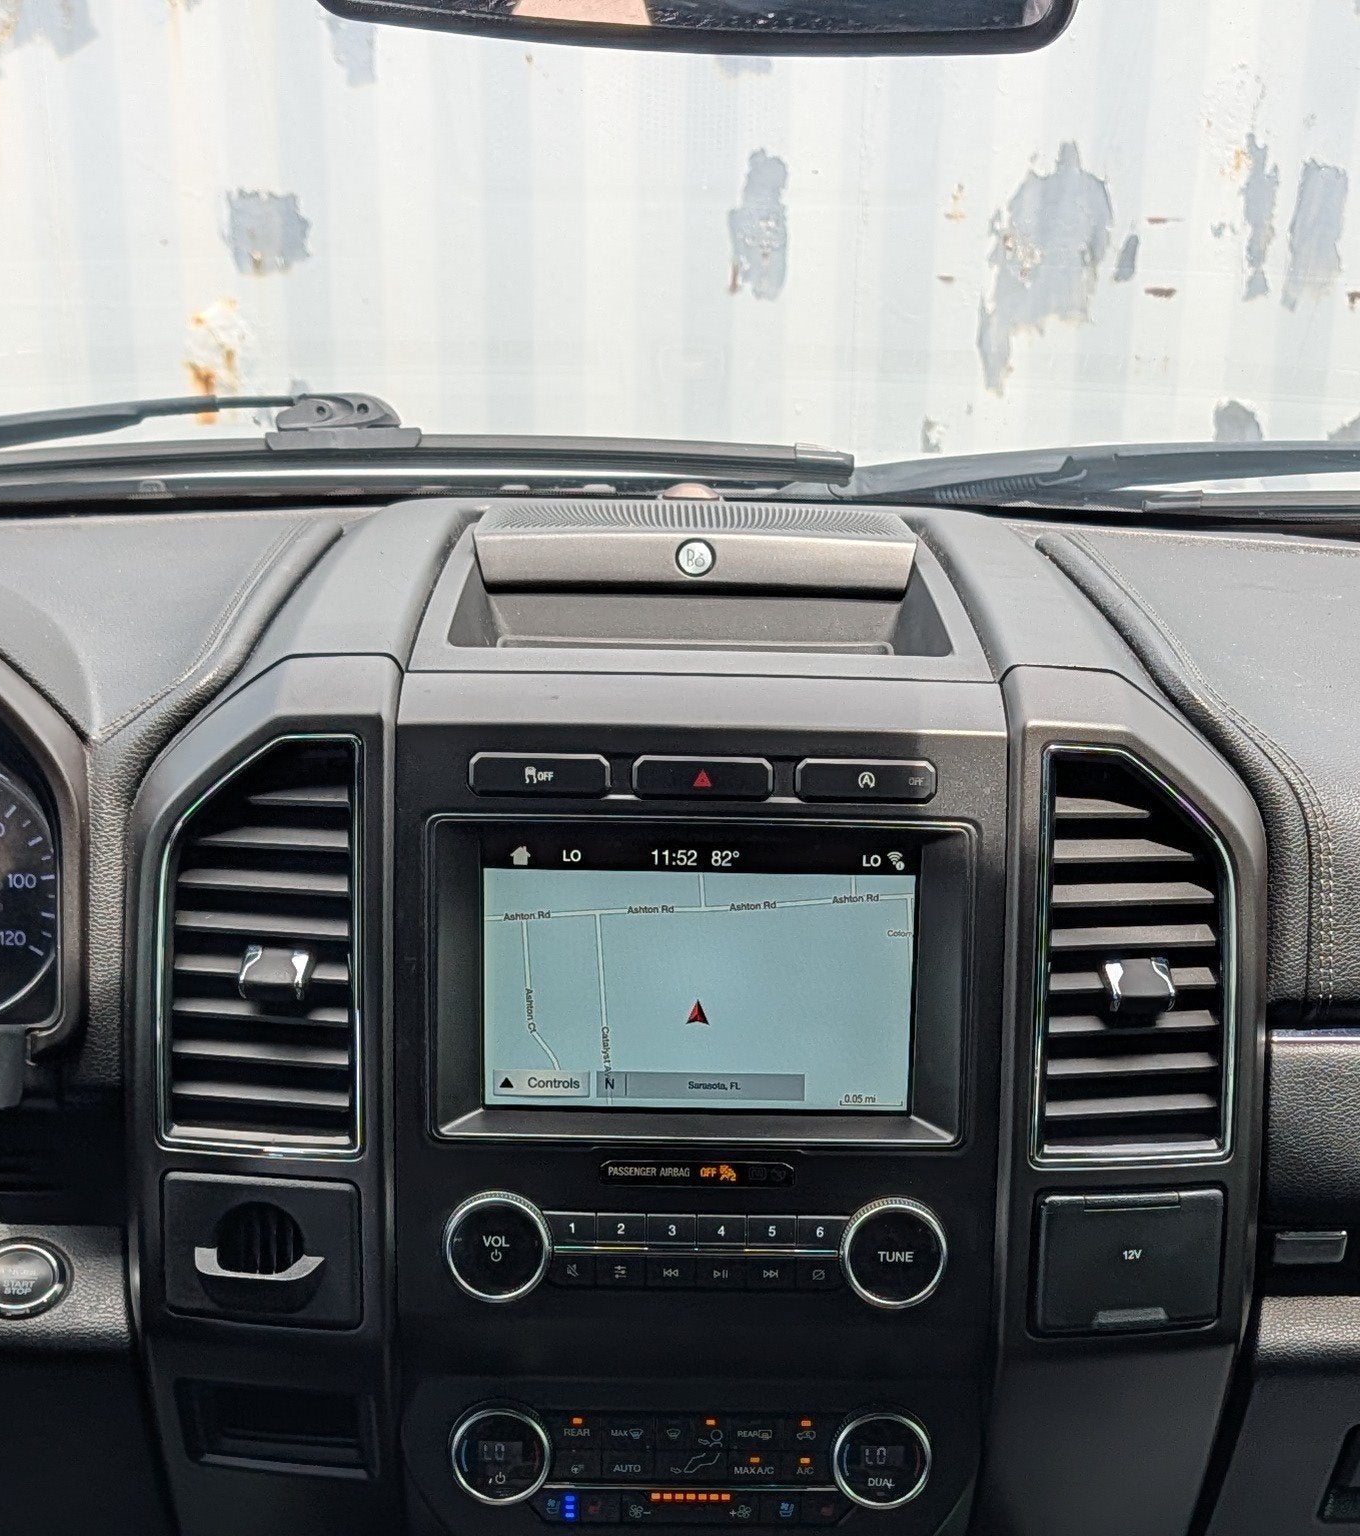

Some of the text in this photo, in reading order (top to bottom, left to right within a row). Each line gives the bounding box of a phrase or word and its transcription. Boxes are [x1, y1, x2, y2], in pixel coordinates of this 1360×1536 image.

[537, 771, 554, 781] OFF
[908, 776, 925, 787] OFF
[562, 850, 582, 862] LO
[651, 850, 698, 866] 11:52
[862, 855, 882, 867] LO
[7, 873, 37, 889] 100
[832, 893, 880, 904] Ashton Rd
[627, 905, 675, 915] Ashton Rd
[729, 901, 777, 911] Ashton Rd
[503, 911, 551, 921] Ashton Rd
[525, 988, 535, 1020] Ashton
[601, 1026, 611, 1063] Catalyst
[527, 1076, 580, 1089] Controls
[605, 1078, 615, 1090] N
[688, 1081, 741, 1091] Sarasota, FL
[844, 1094, 877, 1104] 0.05 mi
[608, 1166, 717, 1178] PASSENGER AIRBAG OFF
[569, 1222, 576, 1234] 1
[617, 1223, 626, 1234] 2
[668, 1224, 677, 1236] 3
[717, 1226, 726, 1236] 4
[768, 1226, 776, 1237] 5
[816, 1226, 824, 1237] 6
[482, 1235, 510, 1247] VOL
[878, 1251, 915, 1263] TUNE
[1122, 1249, 1143, 1260] 12V
[3, 1280, 36, 1288] START
[4, 1287, 32, 1295] STOP
[563, 1428, 591, 1437] REAR
[610, 1429, 629, 1437] MAX
[613, 1464, 641, 1473] AUTO
[734, 1466, 775, 1475] MAX A/C
[796, 1466, 815, 1475] A/C
[867, 1477, 896, 1488] DUAL
